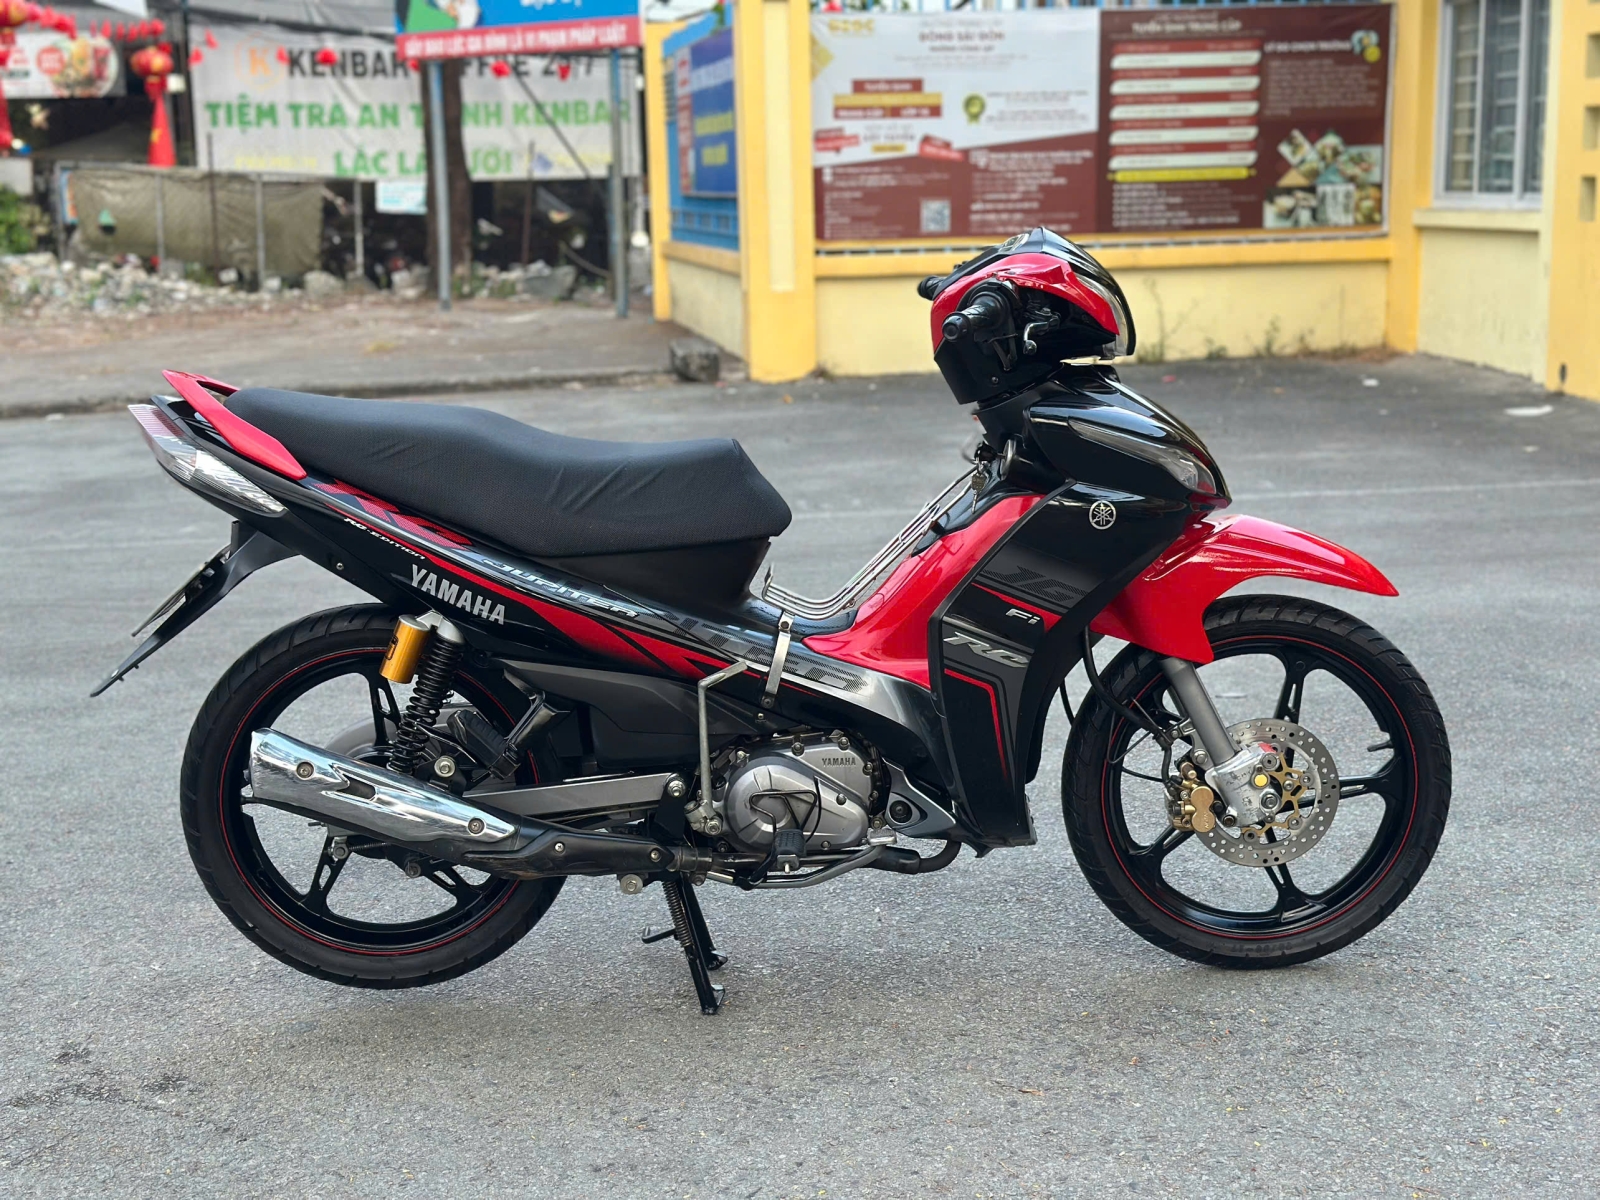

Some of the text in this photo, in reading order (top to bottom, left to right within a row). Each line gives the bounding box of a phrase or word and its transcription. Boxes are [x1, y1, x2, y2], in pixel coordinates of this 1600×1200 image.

[289, 49, 408, 77] KENBAR
[205, 93, 278, 134] TIỆM
[358, 103, 399, 128] AN
[408, 102, 502, 128] TNH
[411, 564, 505, 625] YAMAHA
[482, 558, 640, 619] JUPITER
[821, 757, 857, 768] YAMAHA
